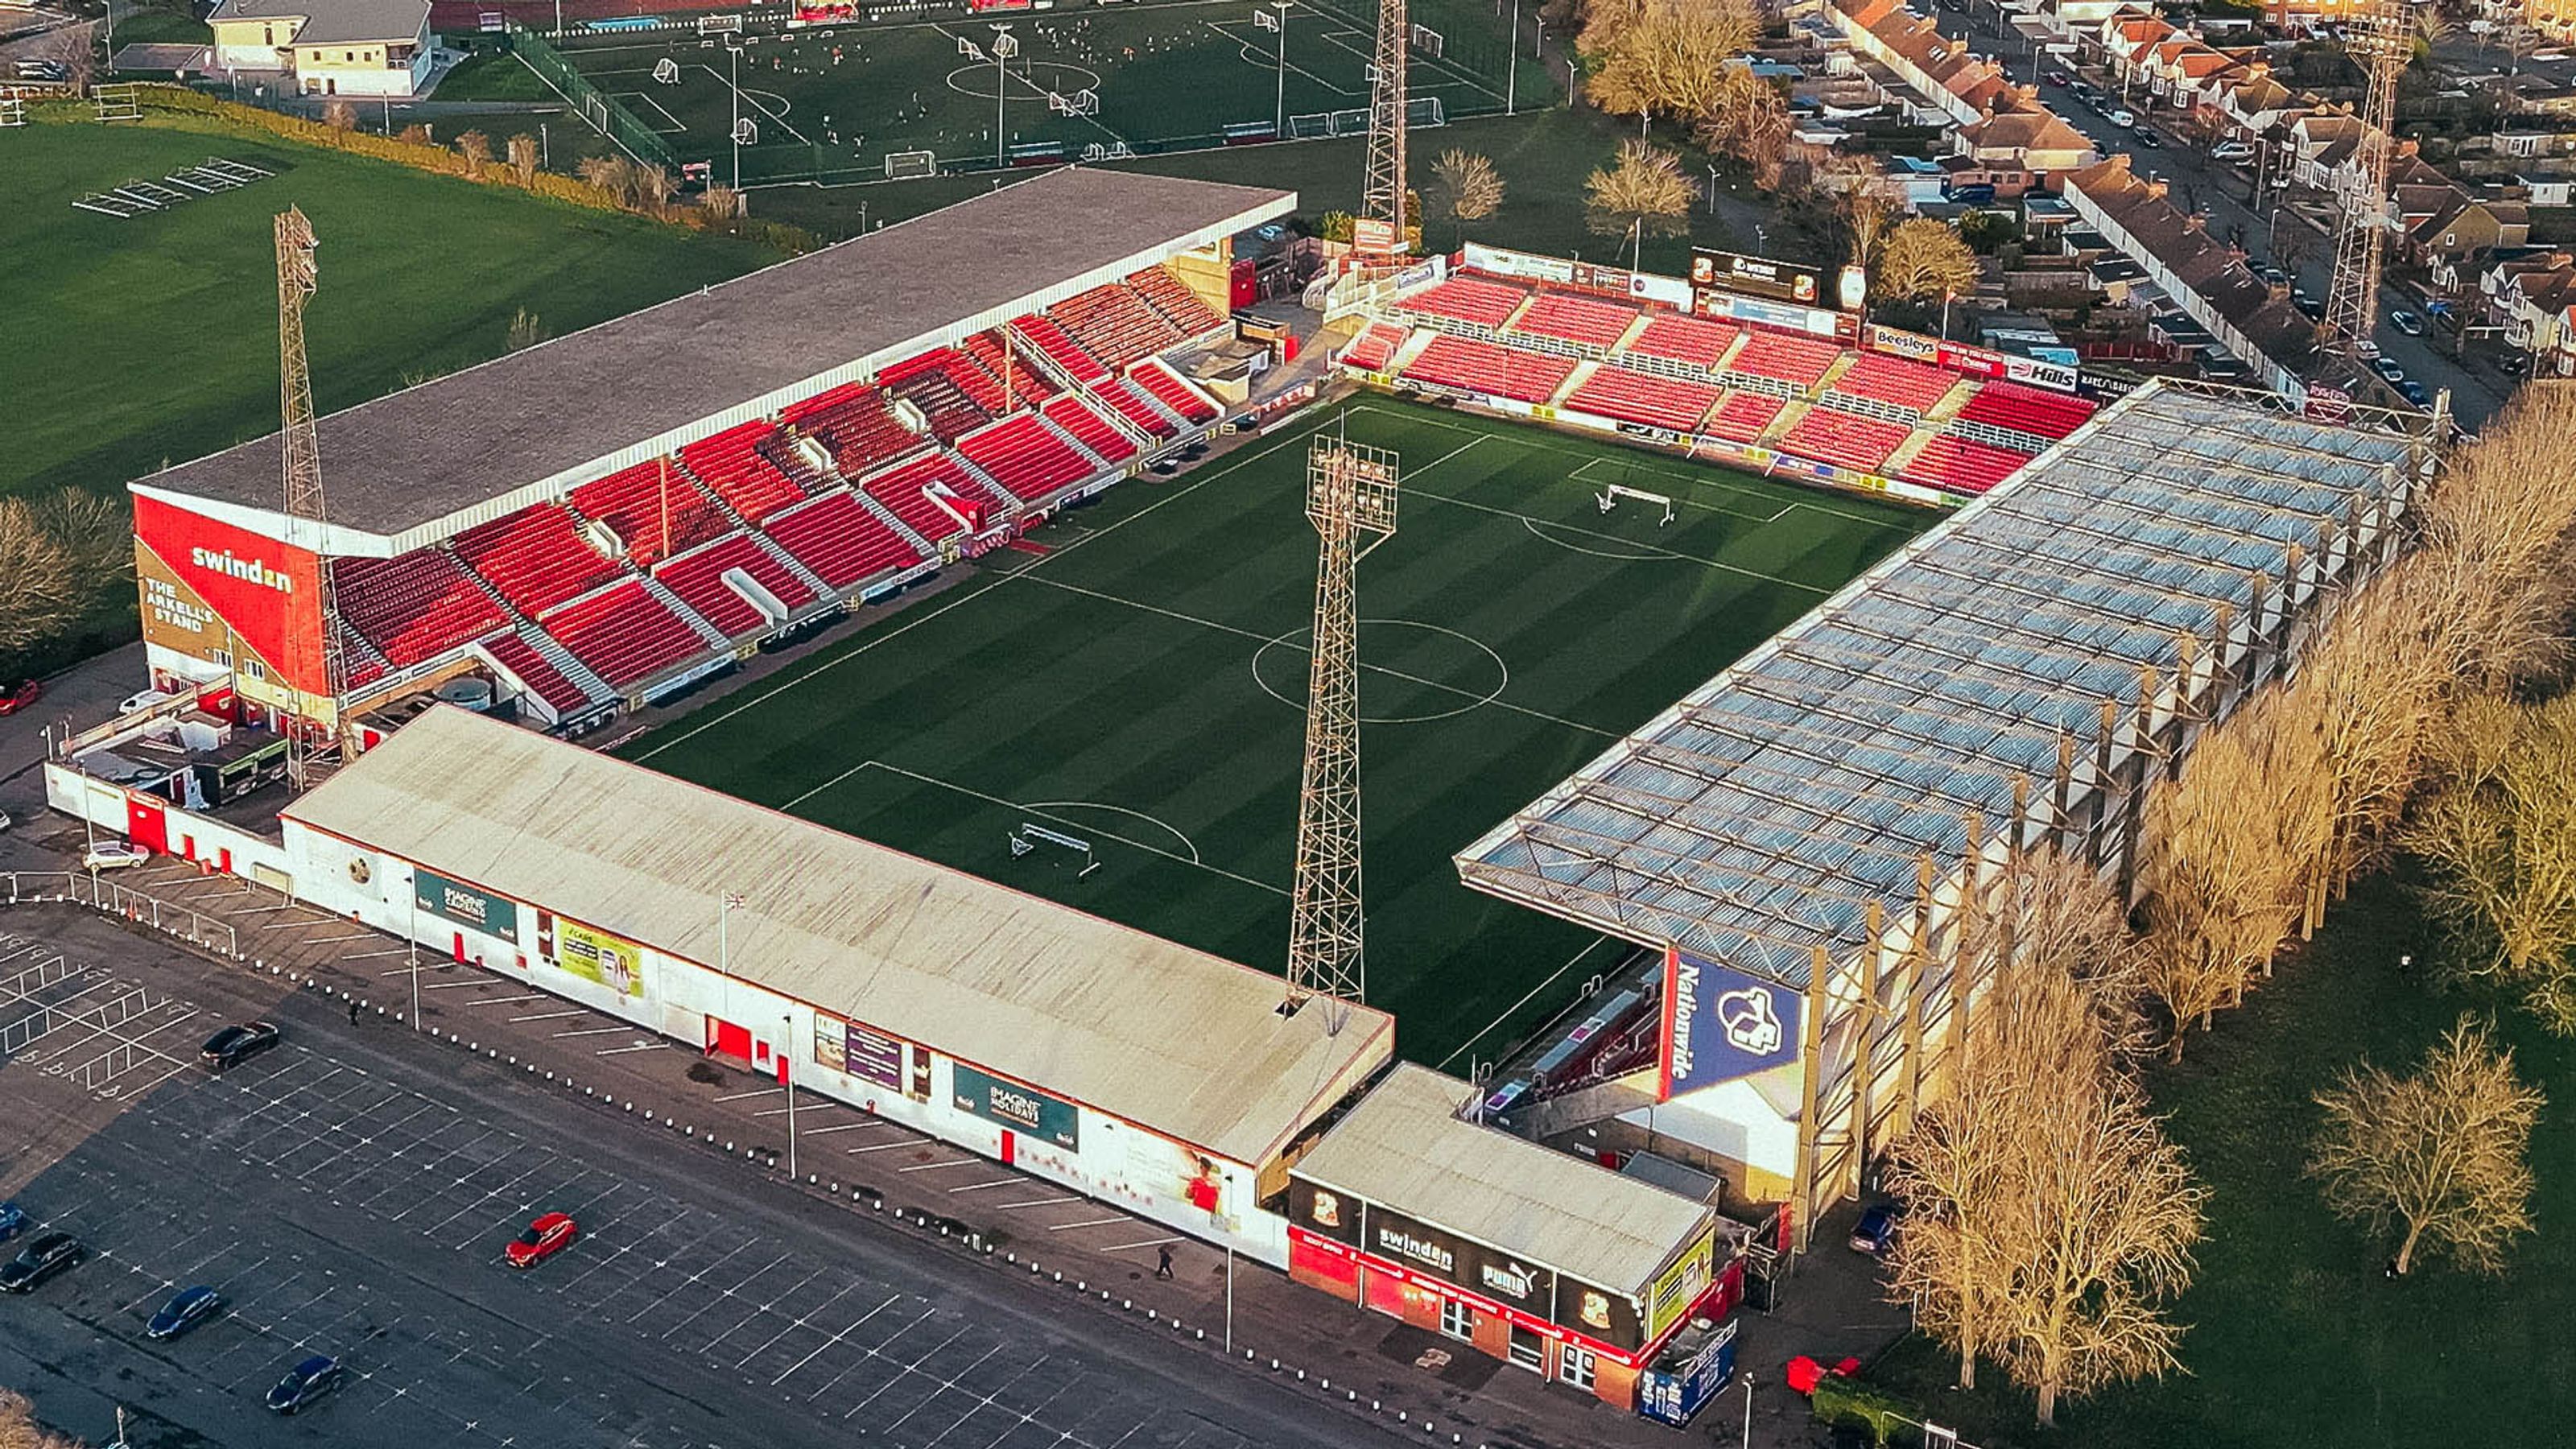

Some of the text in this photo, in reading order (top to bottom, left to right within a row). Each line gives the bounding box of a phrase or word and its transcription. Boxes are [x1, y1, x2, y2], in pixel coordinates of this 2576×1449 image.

[1877, 331, 1935, 353] Beesleys
[2031, 366, 2074, 386] Hills
[145, 577, 176, 598] THE
[147, 592, 213, 623] ARKELL'S
[155, 608, 202, 634] STAND
[1671, 961, 1701, 1080] Nationwide
[1483, 1265, 1525, 1294] PUMA
